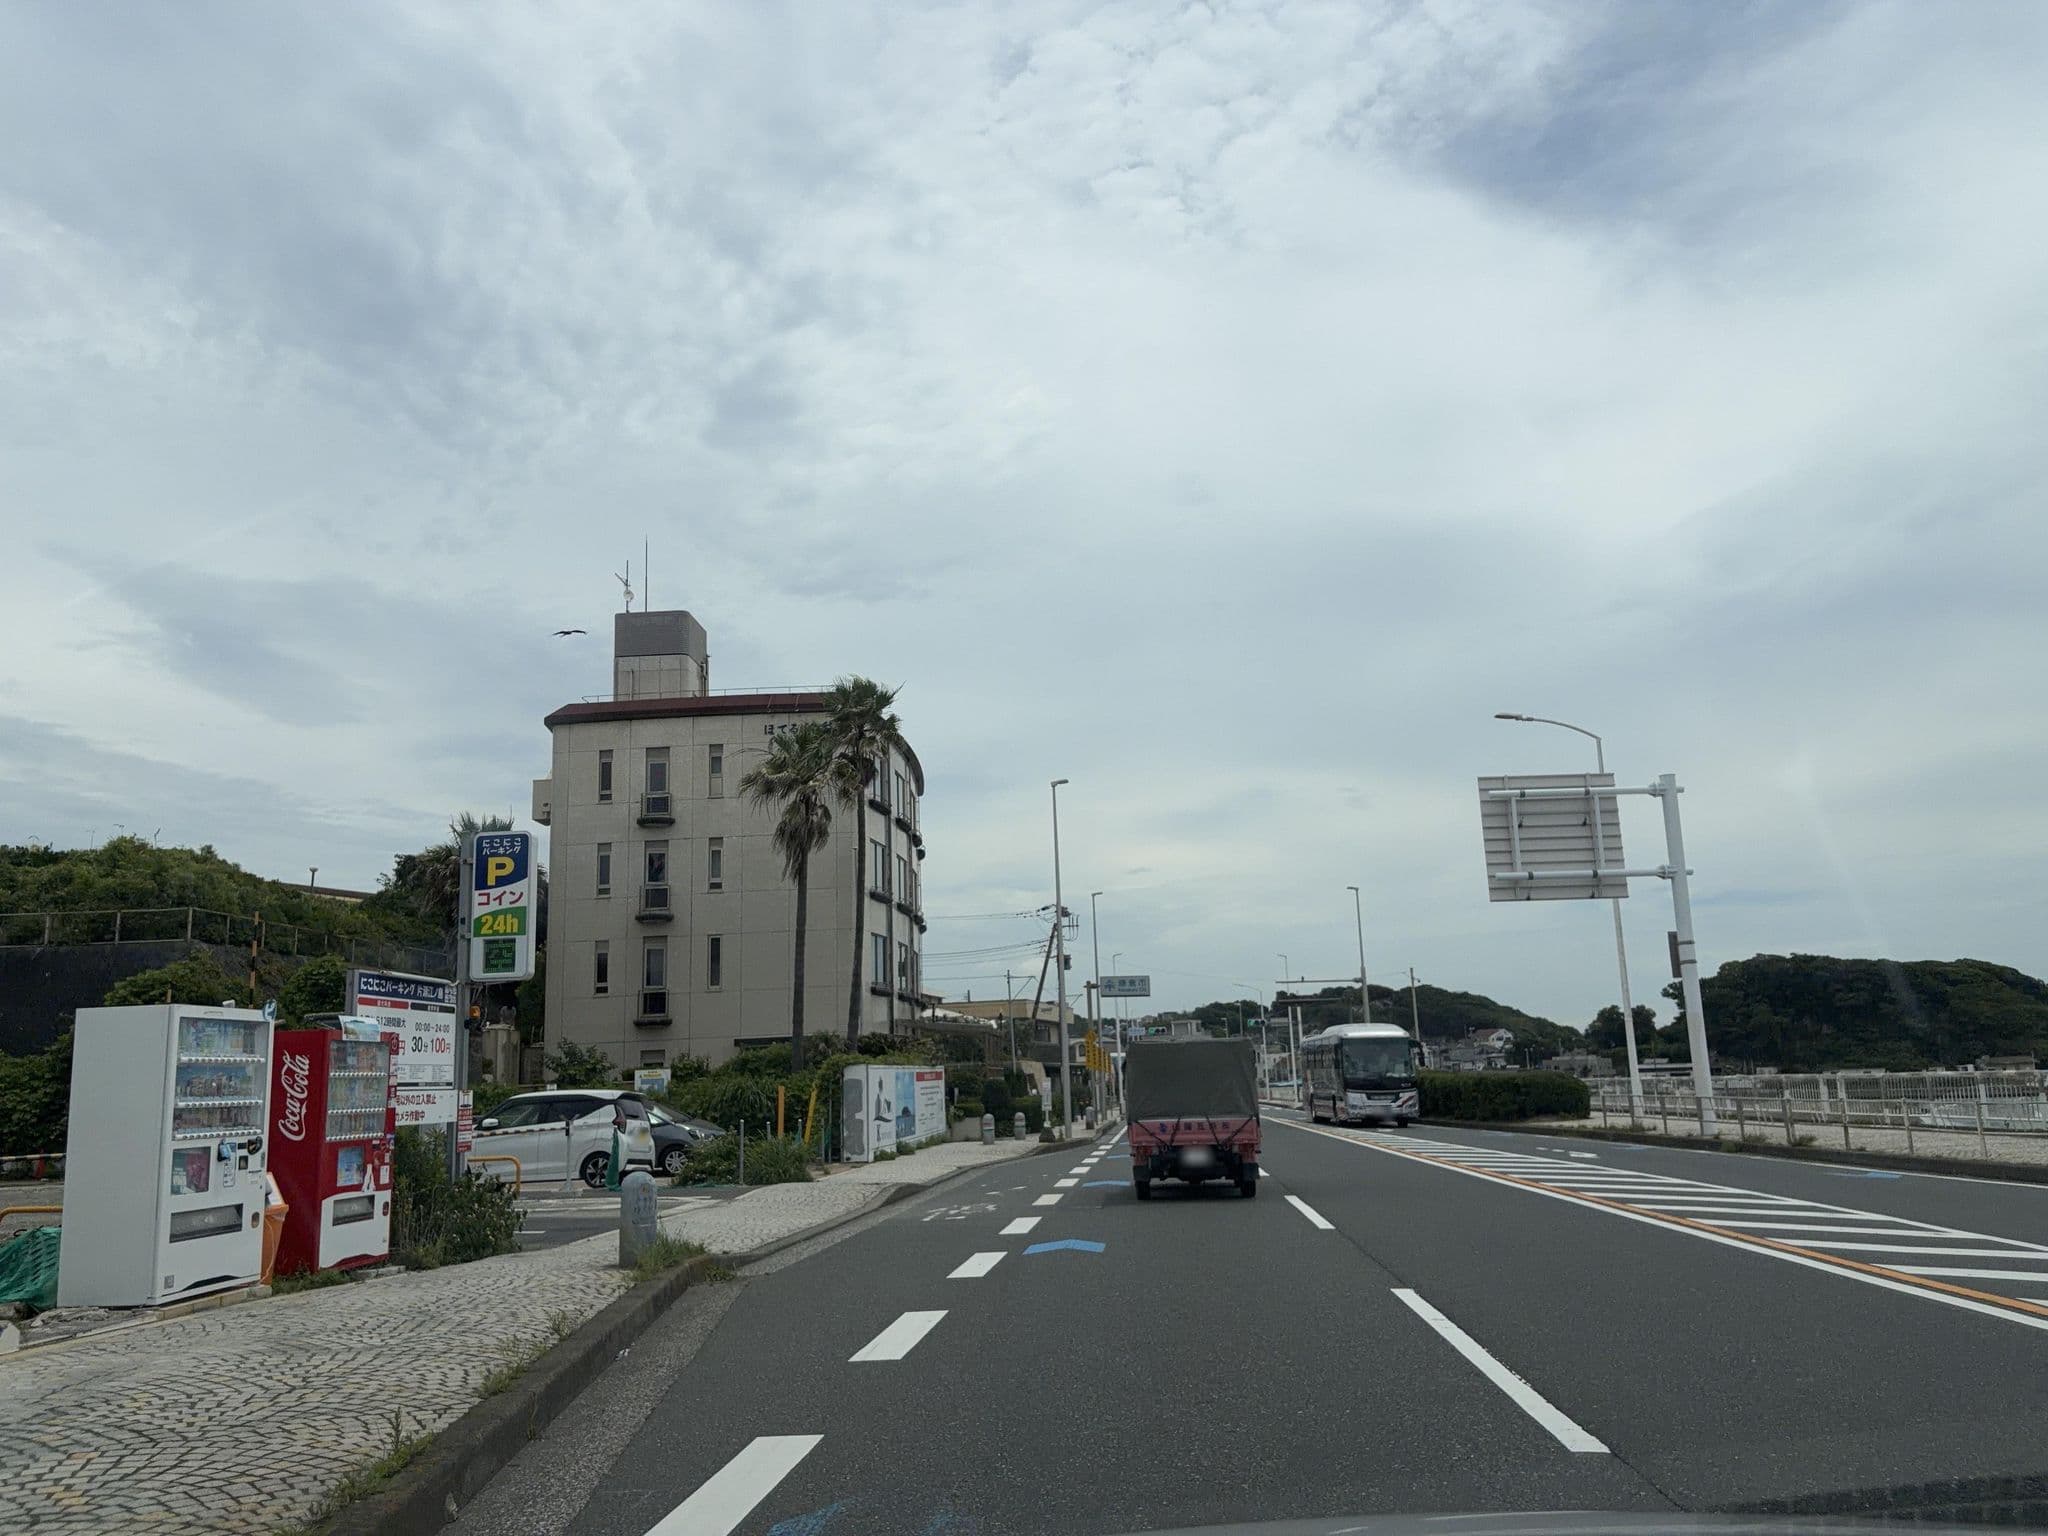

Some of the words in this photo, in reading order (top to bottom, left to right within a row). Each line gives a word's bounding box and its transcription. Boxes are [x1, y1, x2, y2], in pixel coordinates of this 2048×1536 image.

[482, 838, 522, 847] にこにこ
[482, 846, 522, 855] パーキング
[487, 856, 515, 886] P
[477, 891, 524, 906] コイン
[480, 913, 519, 935] 24h
[360, 977, 416, 995] にこにこパーキング
